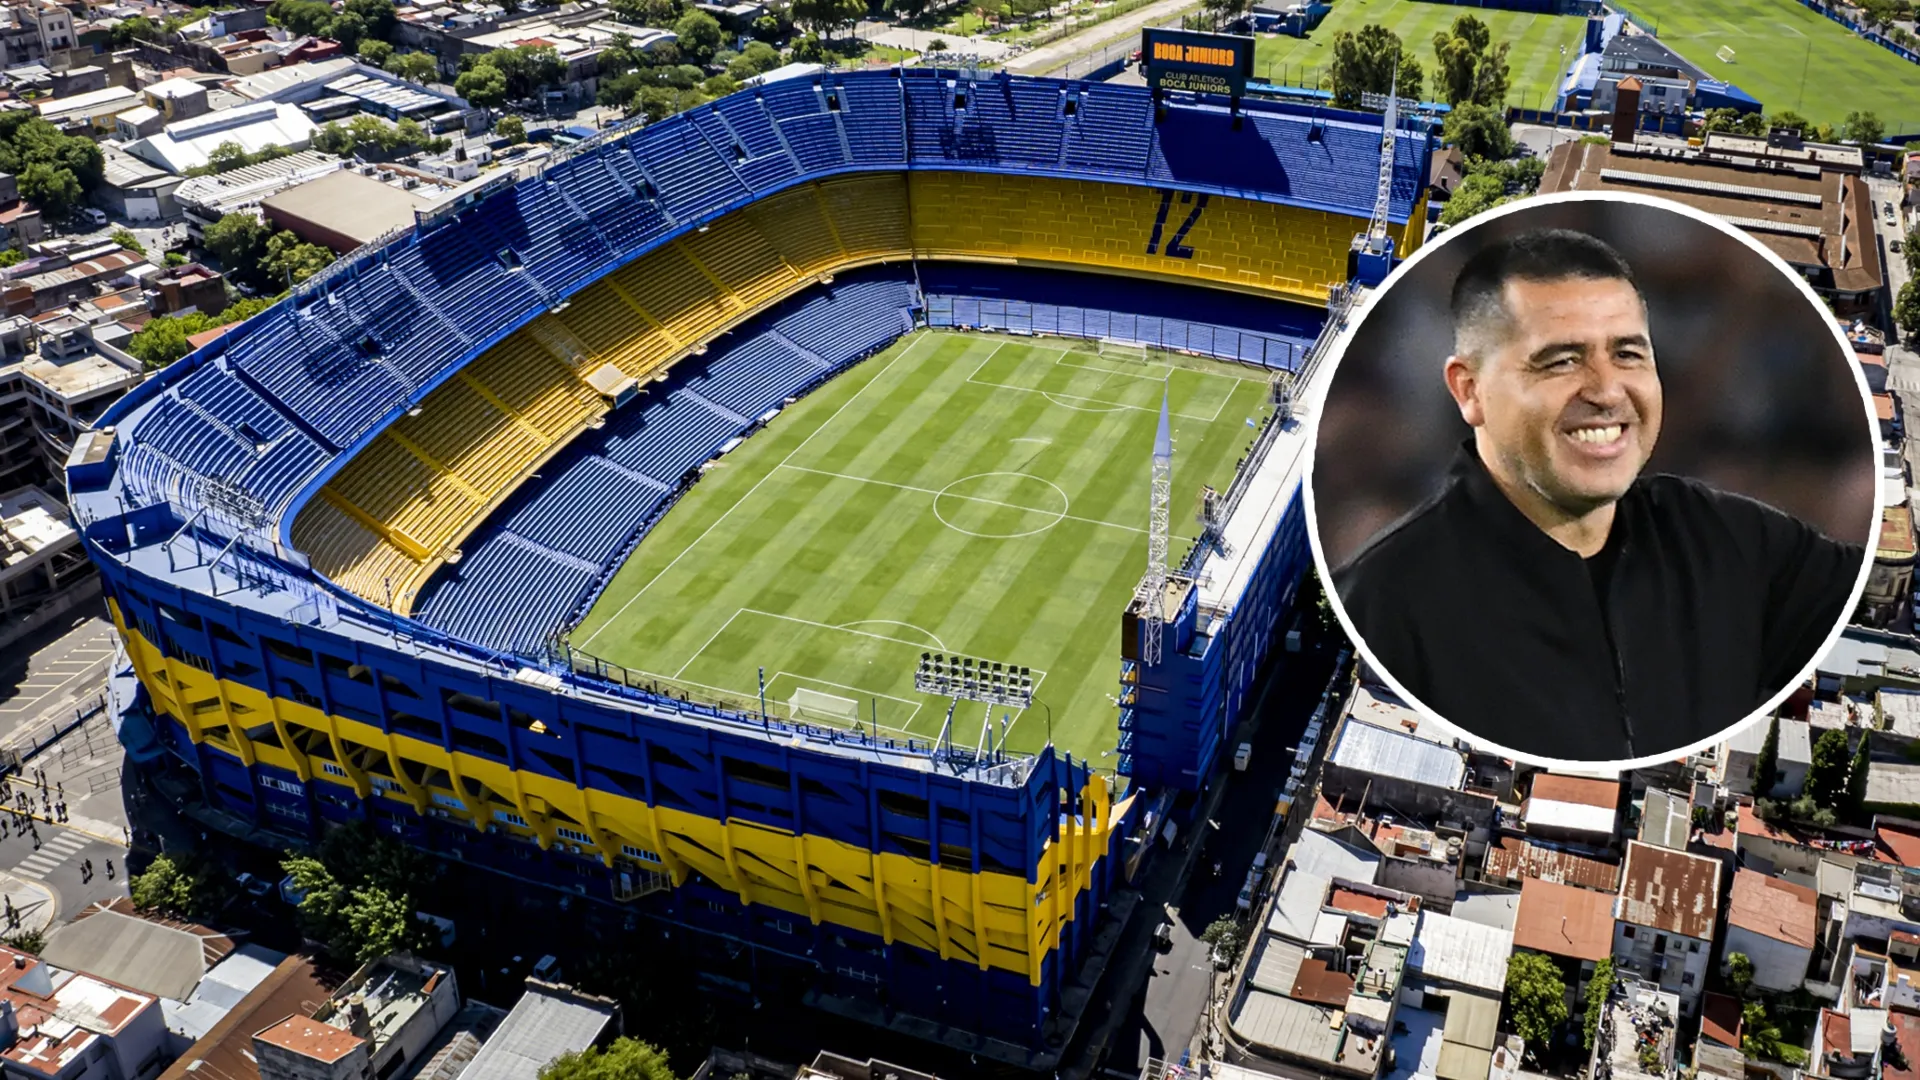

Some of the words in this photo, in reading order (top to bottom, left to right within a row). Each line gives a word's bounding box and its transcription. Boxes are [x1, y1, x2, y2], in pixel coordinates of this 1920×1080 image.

[1154, 42, 1183, 61] BOCA
[1185, 46, 1234, 66] JUNIORS
[1165, 71, 1187, 79] CLUB
[1159, 78, 1186, 89] BOCA
[1188, 81, 1231, 94] JUNIORS
[1146, 188, 1209, 259] 12
